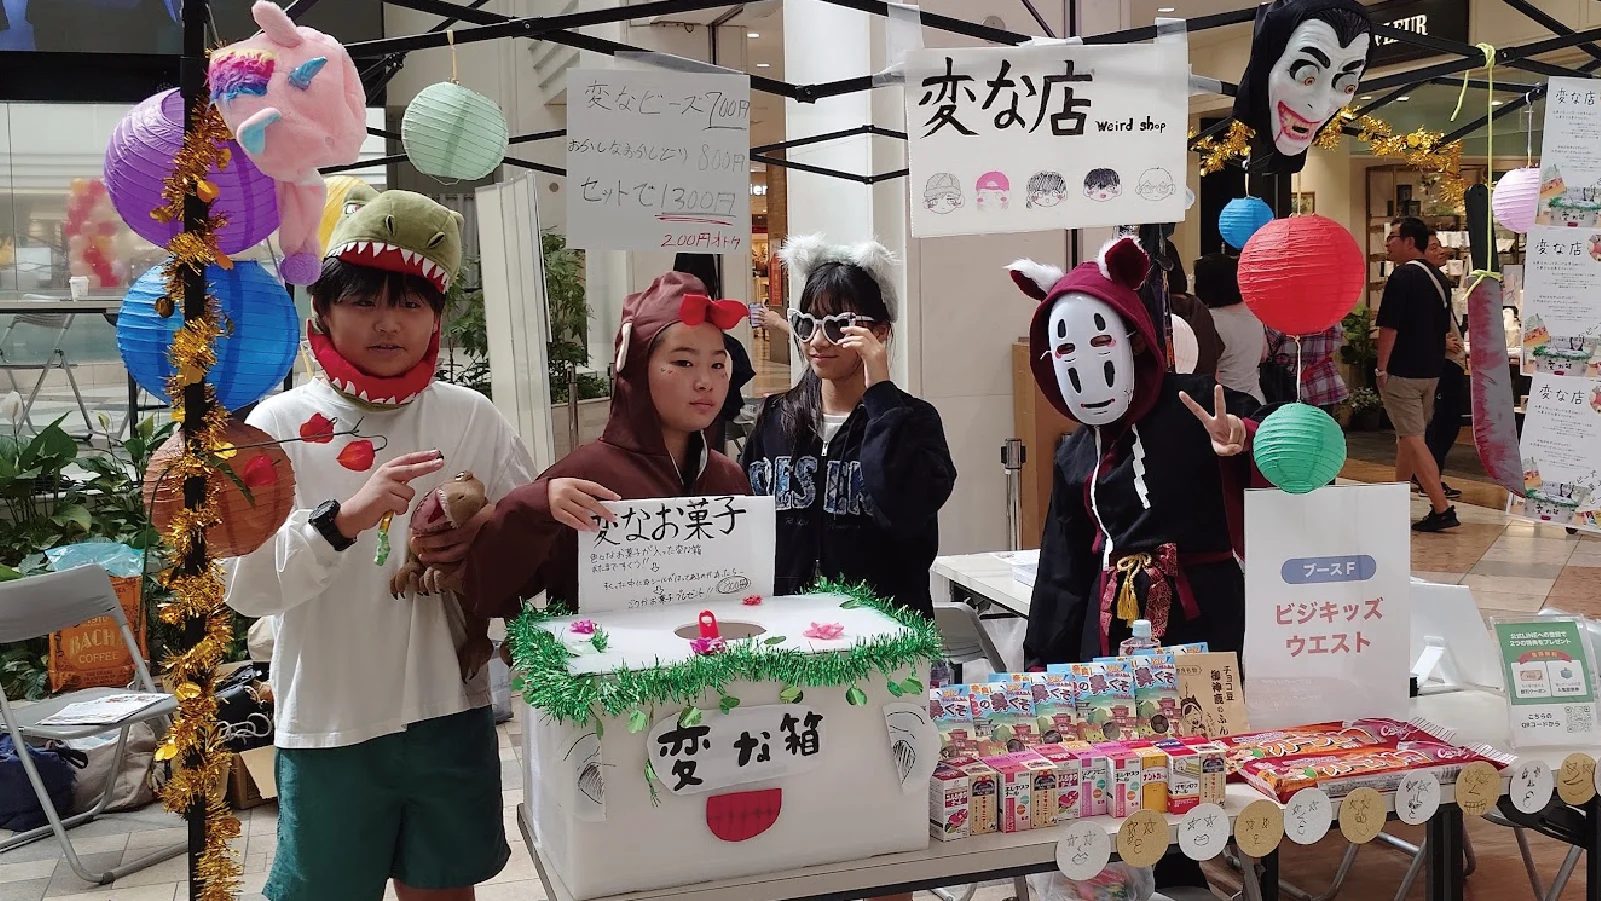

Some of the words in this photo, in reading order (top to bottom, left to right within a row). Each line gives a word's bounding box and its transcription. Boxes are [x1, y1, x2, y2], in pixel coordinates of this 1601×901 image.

[919, 57, 1093, 138] 変な店
[1139, 116, 1166, 134] shop
[1276, 597, 1384, 625] ビジキッズ
[79, 651, 119, 664] COFFEE
[1286, 631, 1371, 658] ウエスト
[658, 711, 823, 791] 変な箱
